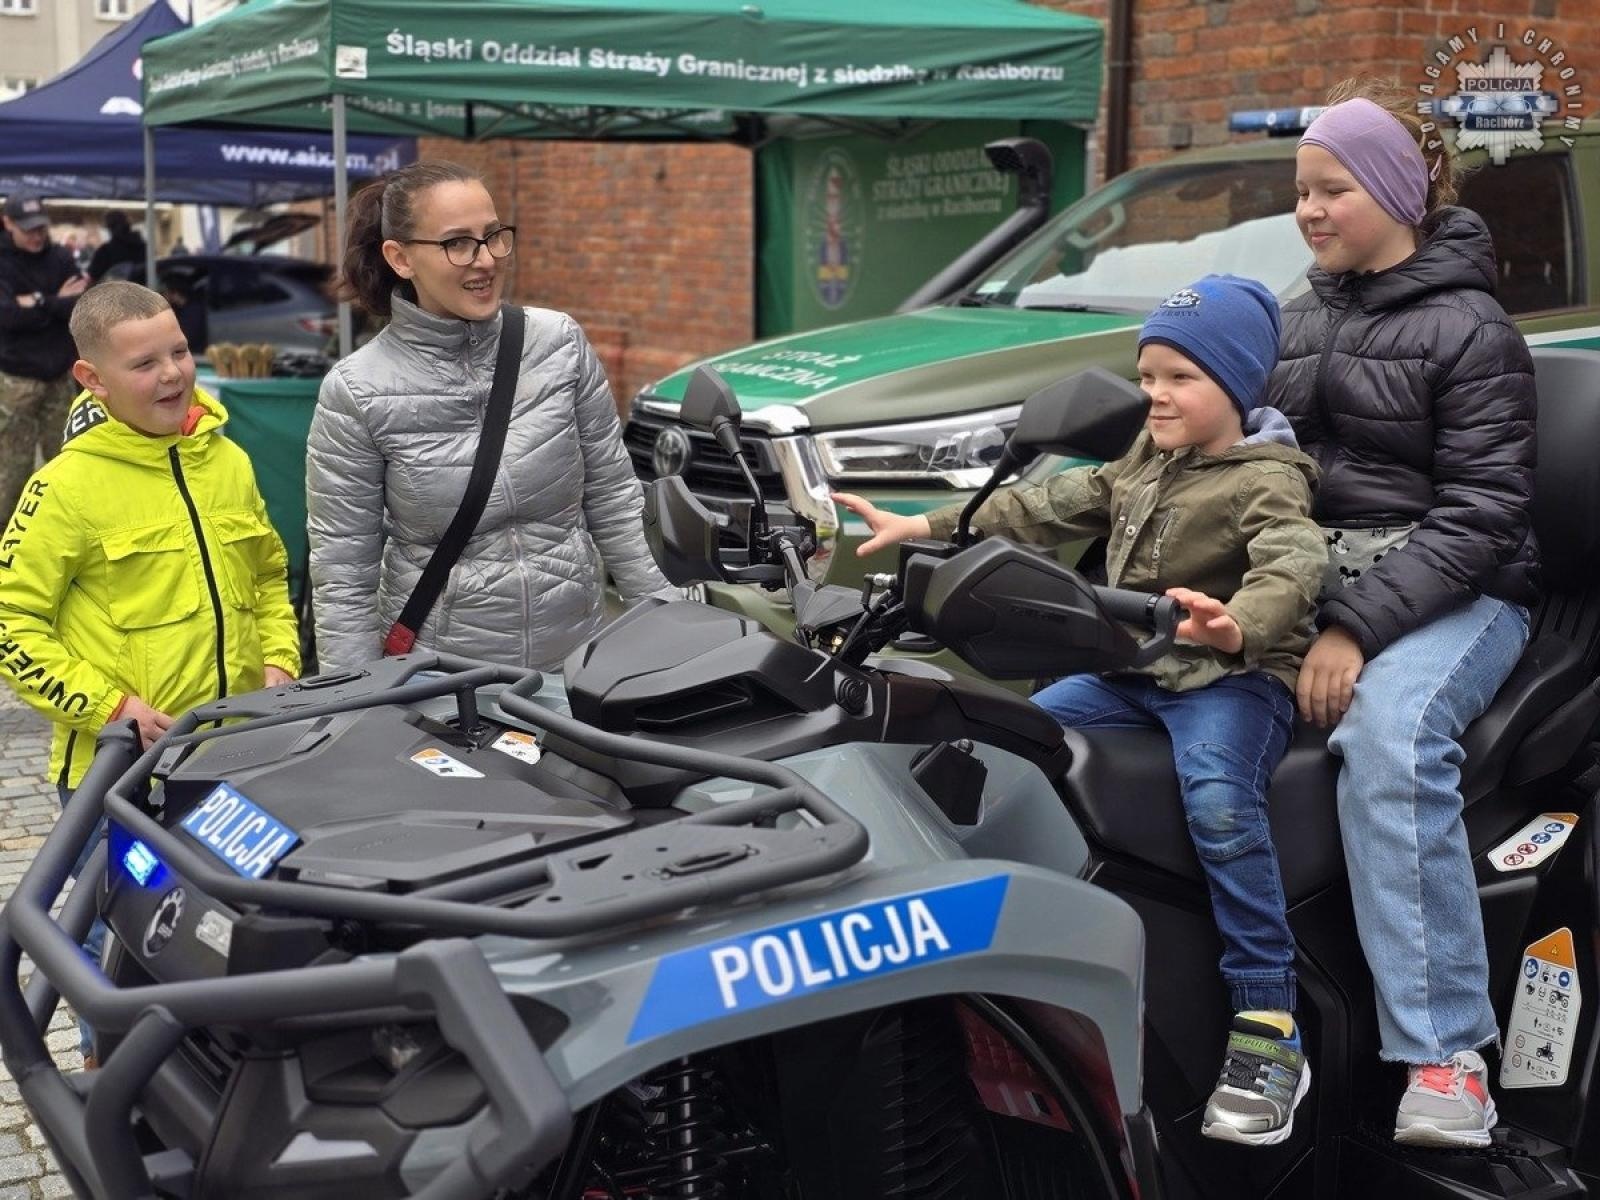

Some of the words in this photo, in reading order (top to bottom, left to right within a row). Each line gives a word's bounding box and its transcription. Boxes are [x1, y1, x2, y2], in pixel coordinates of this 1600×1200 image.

[386, 28, 472, 62] Śląski
[588, 48, 671, 77] Straży
[677, 53, 808, 88] Granicznej
[813, 66, 828, 84] z
[221, 145, 398, 176] www.aixm.pl
[186, 788, 289, 878] POLICJA
[710, 898, 951, 1008] POLICJA
